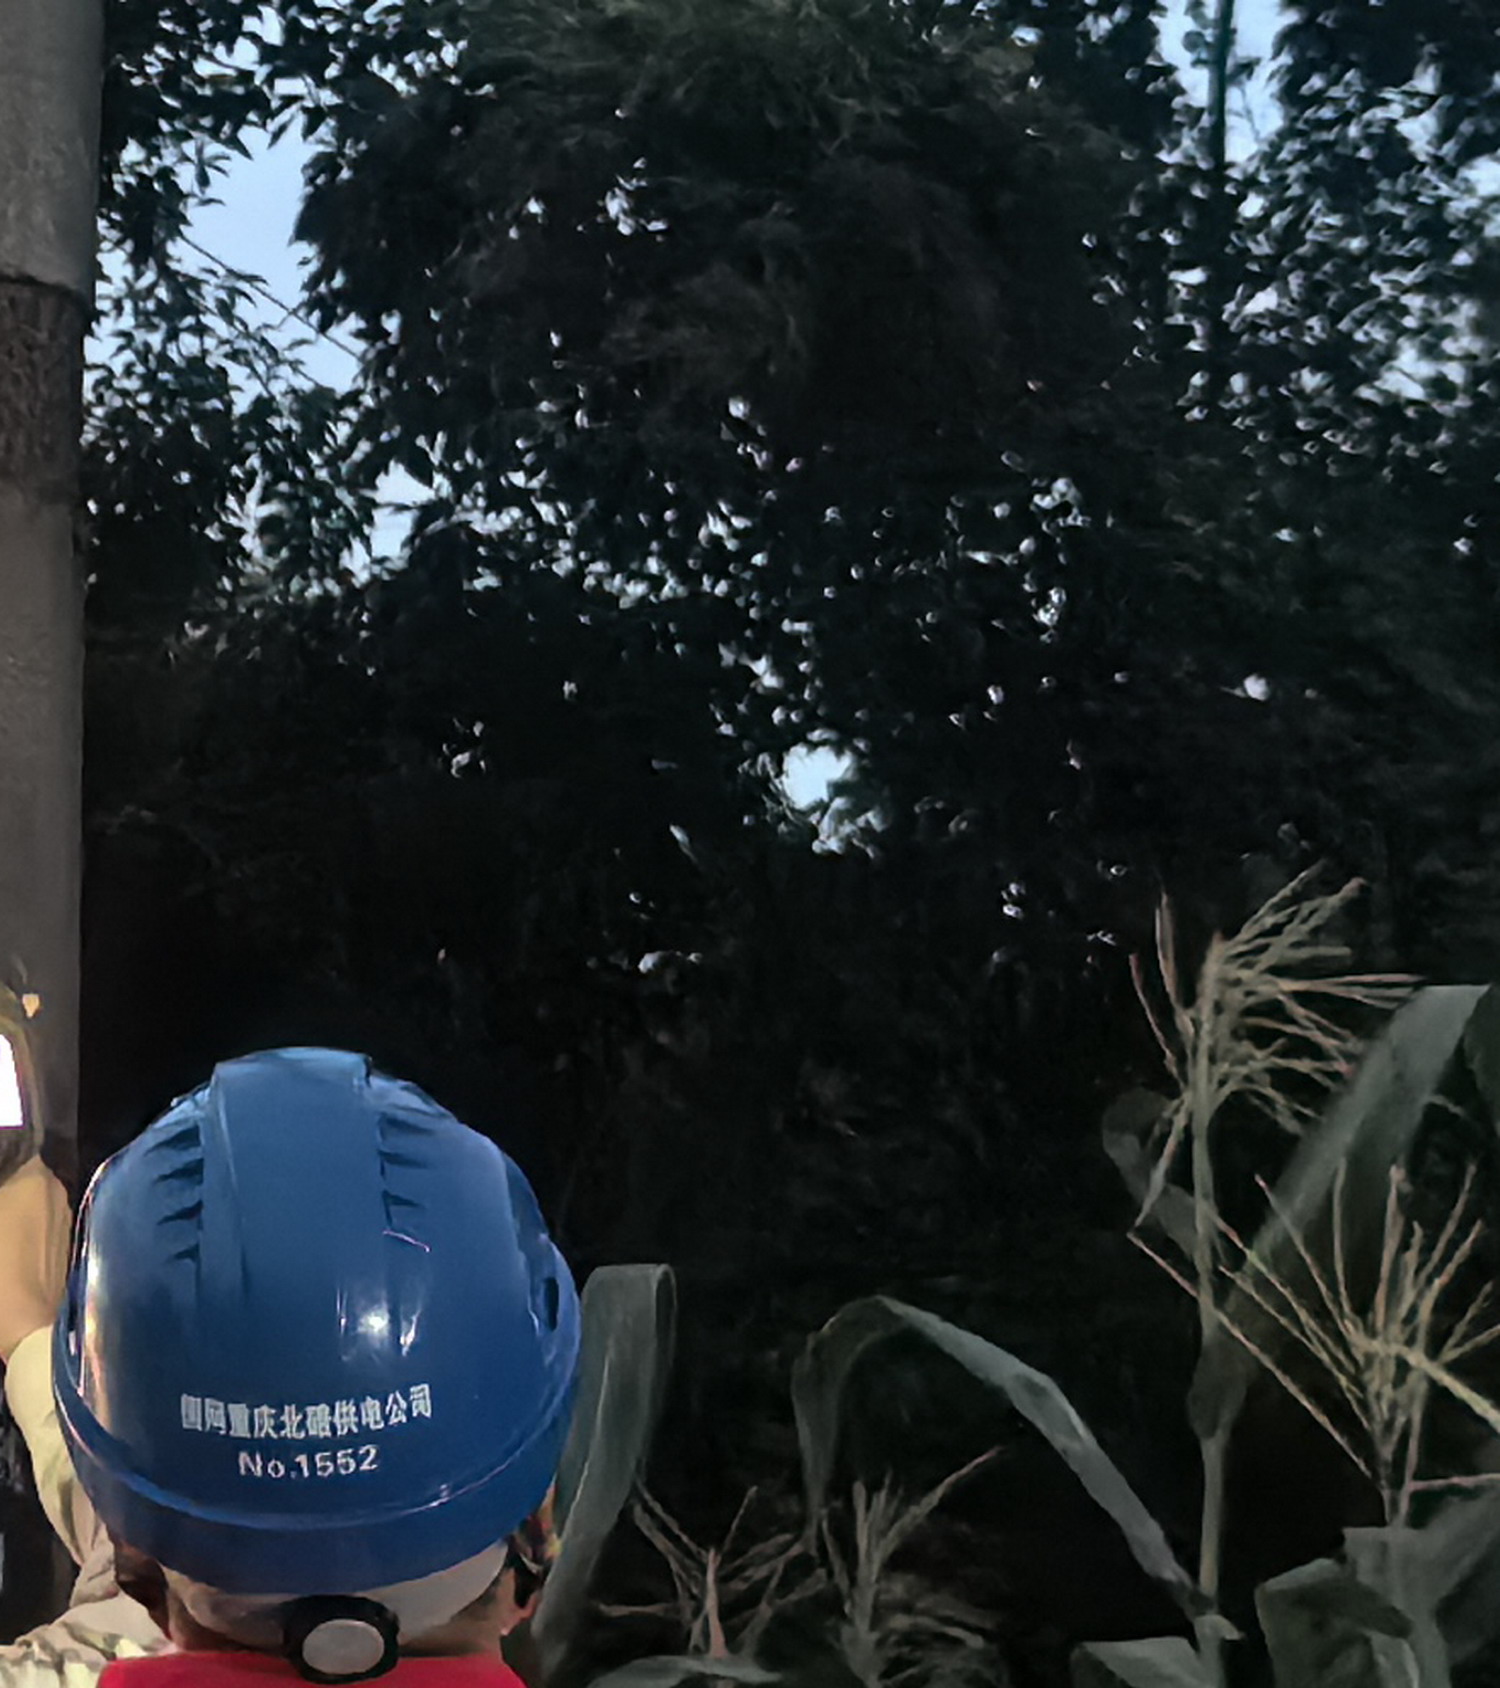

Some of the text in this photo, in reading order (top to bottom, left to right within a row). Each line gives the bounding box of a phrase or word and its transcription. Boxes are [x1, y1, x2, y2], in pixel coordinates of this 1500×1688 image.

[181, 1383, 433, 1438] 国网重庆北碚供电公司
[238, 1444, 379, 1478] No.1552
